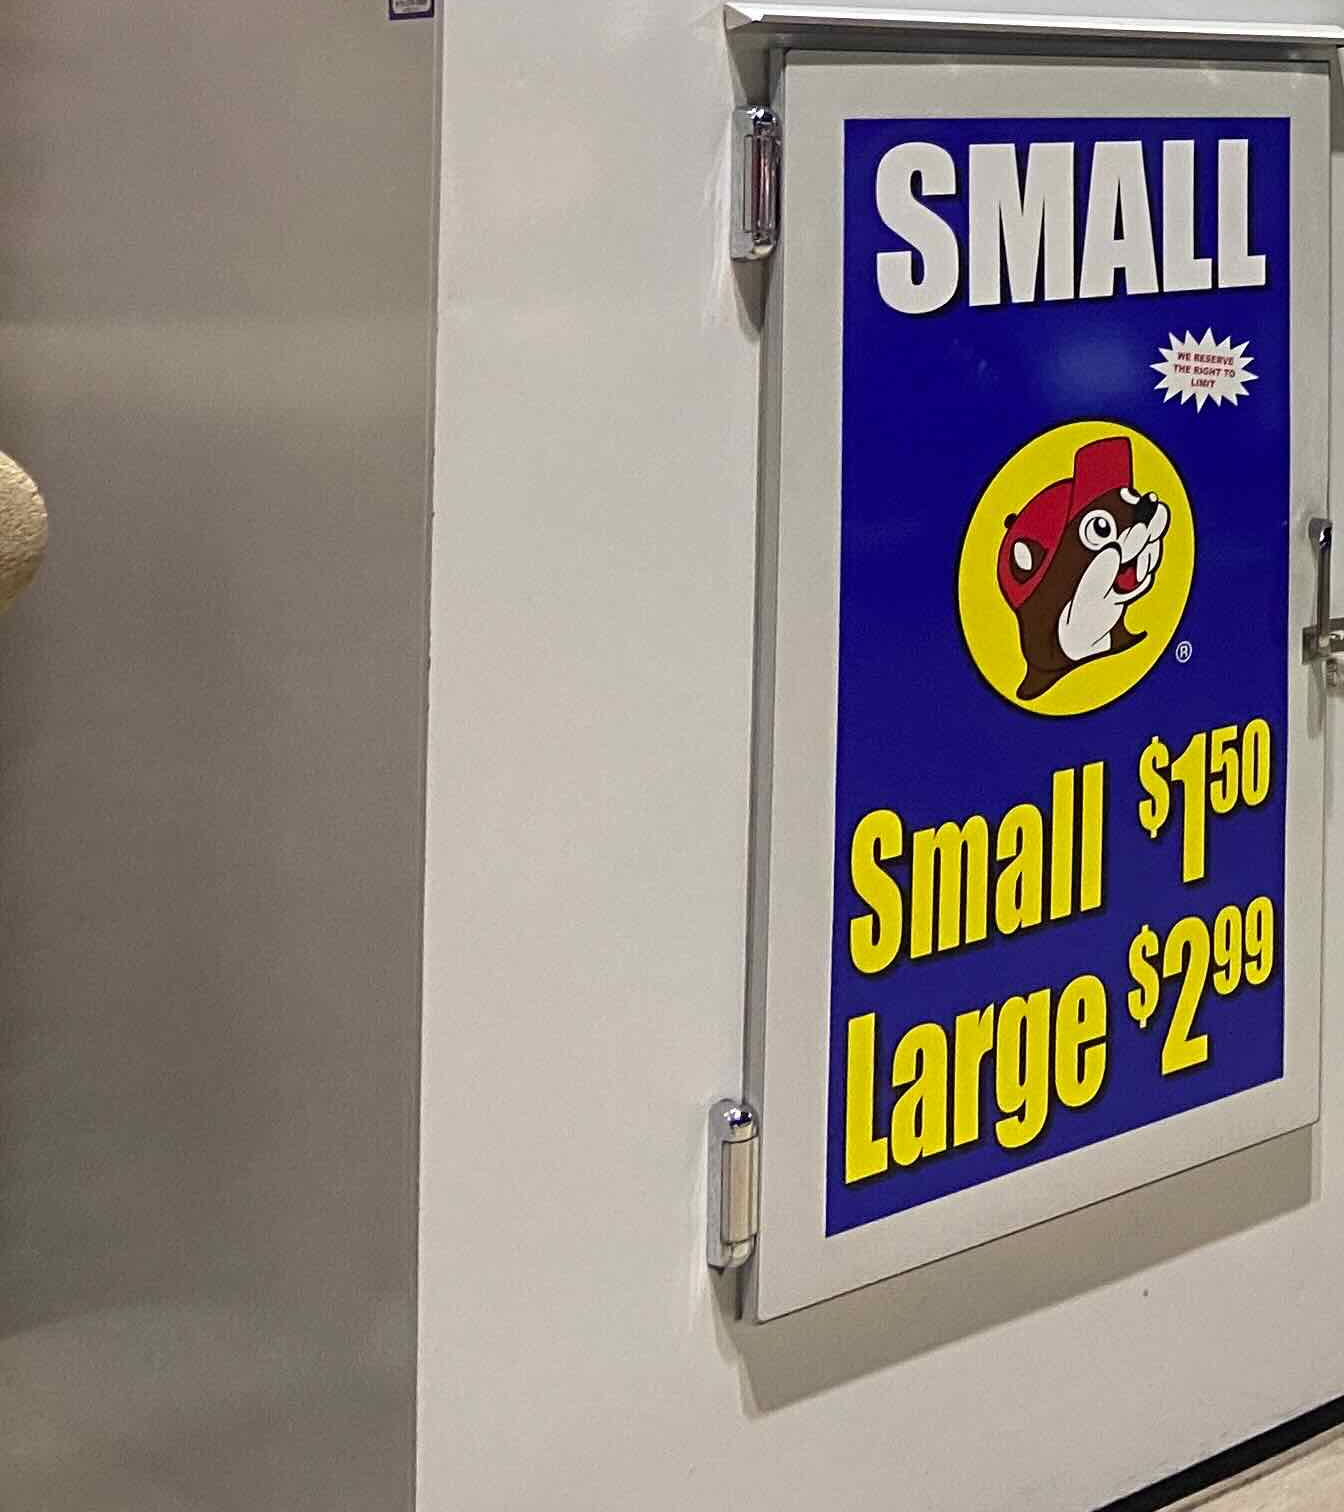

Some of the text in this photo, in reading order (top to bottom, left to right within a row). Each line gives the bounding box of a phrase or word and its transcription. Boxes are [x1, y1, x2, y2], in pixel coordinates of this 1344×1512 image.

[876, 139, 1266, 314] SMALL
[1174, 364, 1236, 378] THE RIGHT TO
[1177, 352, 1233, 365] WE RESERVE
[1191, 378, 1216, 388] LIMIT
[849, 761, 1104, 974] Small
[844, 974, 1108, 1186] Large
